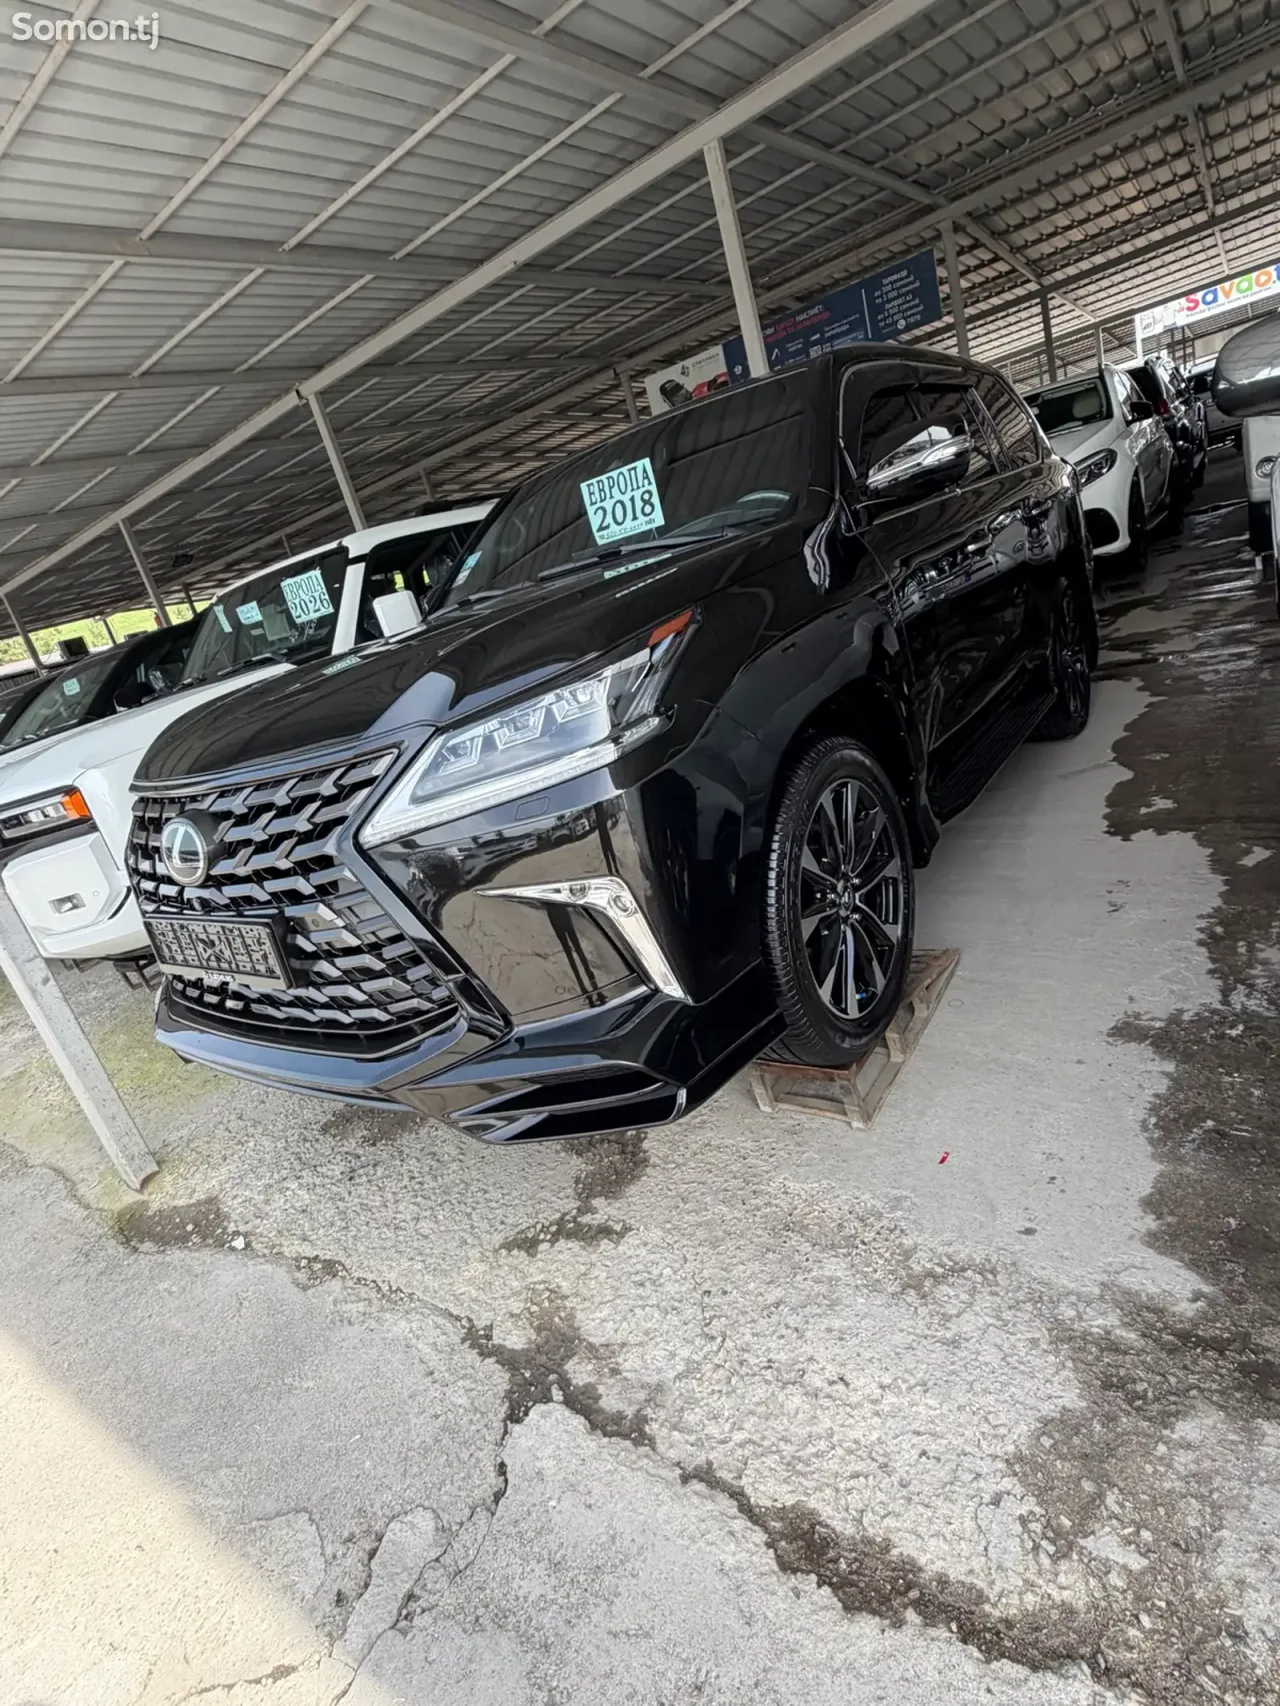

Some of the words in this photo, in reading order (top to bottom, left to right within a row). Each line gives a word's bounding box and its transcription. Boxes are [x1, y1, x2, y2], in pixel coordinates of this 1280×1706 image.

[586, 462, 653, 506] ЕВРОПА
[593, 489, 655, 533] 2018
[282, 574, 325, 603] ЕВРОПА
[290, 591, 330, 619] 2026
